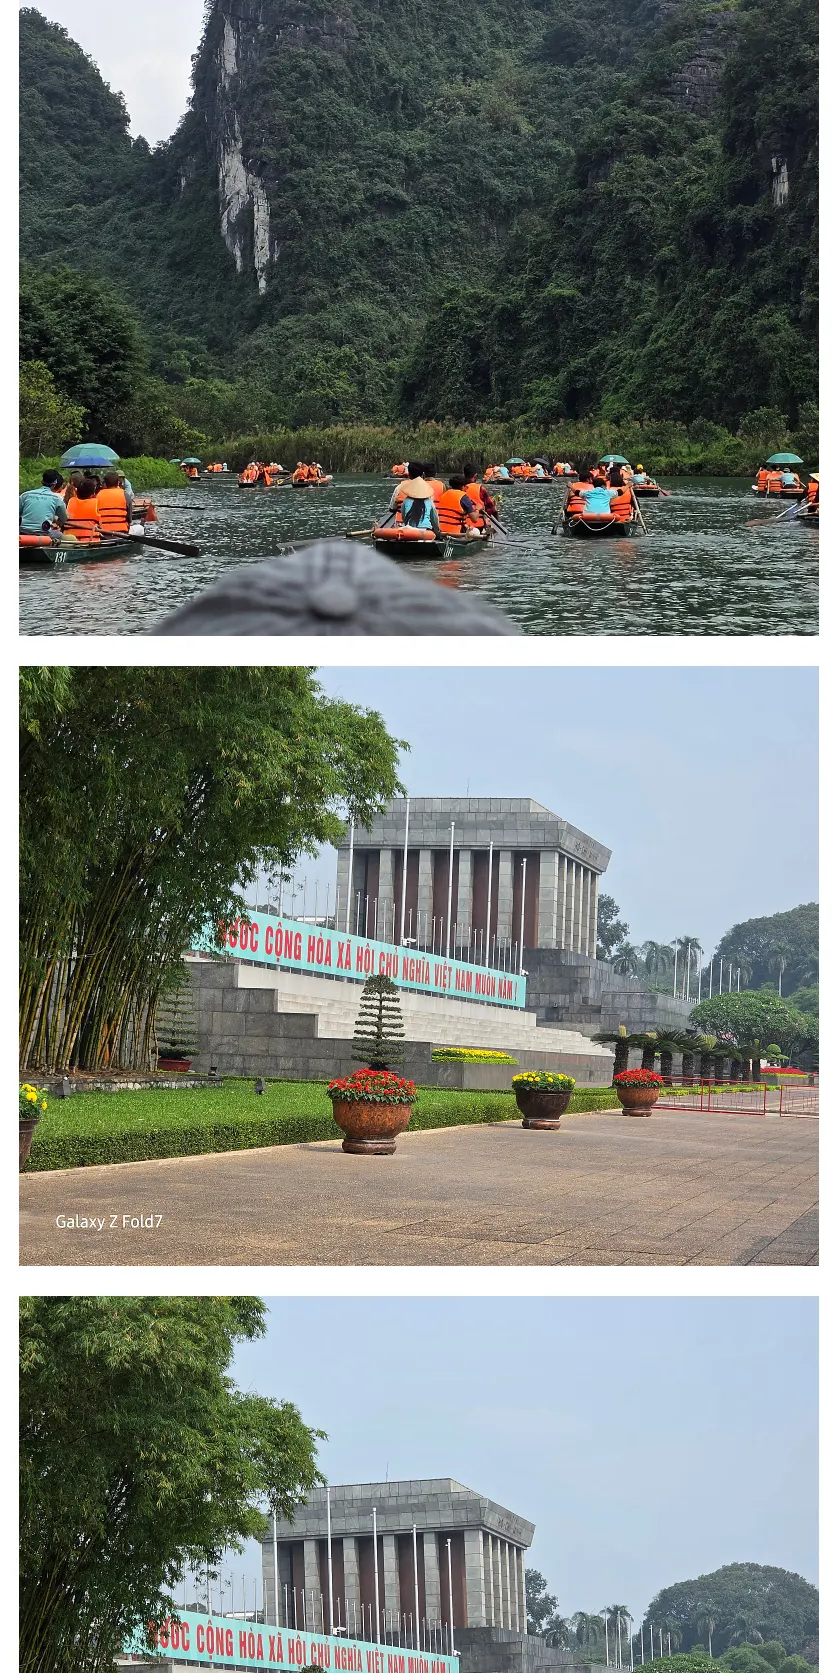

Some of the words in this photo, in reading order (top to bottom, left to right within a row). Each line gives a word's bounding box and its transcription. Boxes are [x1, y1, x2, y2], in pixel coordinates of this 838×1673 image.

[54, 551, 68, 563] 131
[265, 921, 302, 962] CỘNG
[307, 932, 331, 966] HÒA
[336, 939, 352, 970] XÃ
[356, 943, 374, 978] HỘI
[379, 947, 399, 979] CHỦ
[402, 956, 430, 985] NGHĨA
[434, 961, 453, 992] VIỆT
[455, 968, 473, 992] NAM
[475, 971, 496, 997] MUÔN
[196, 1619, 233, 1660] CỘNG
[239, 1627, 264, 1660] HÒA
[268, 1631, 284, 1663] XÃ
[288, 1634, 307, 1669] HỘI
[310, 1636, 331, 1668] CHỦ
[334, 1644, 363, 1672] NGHĨA
